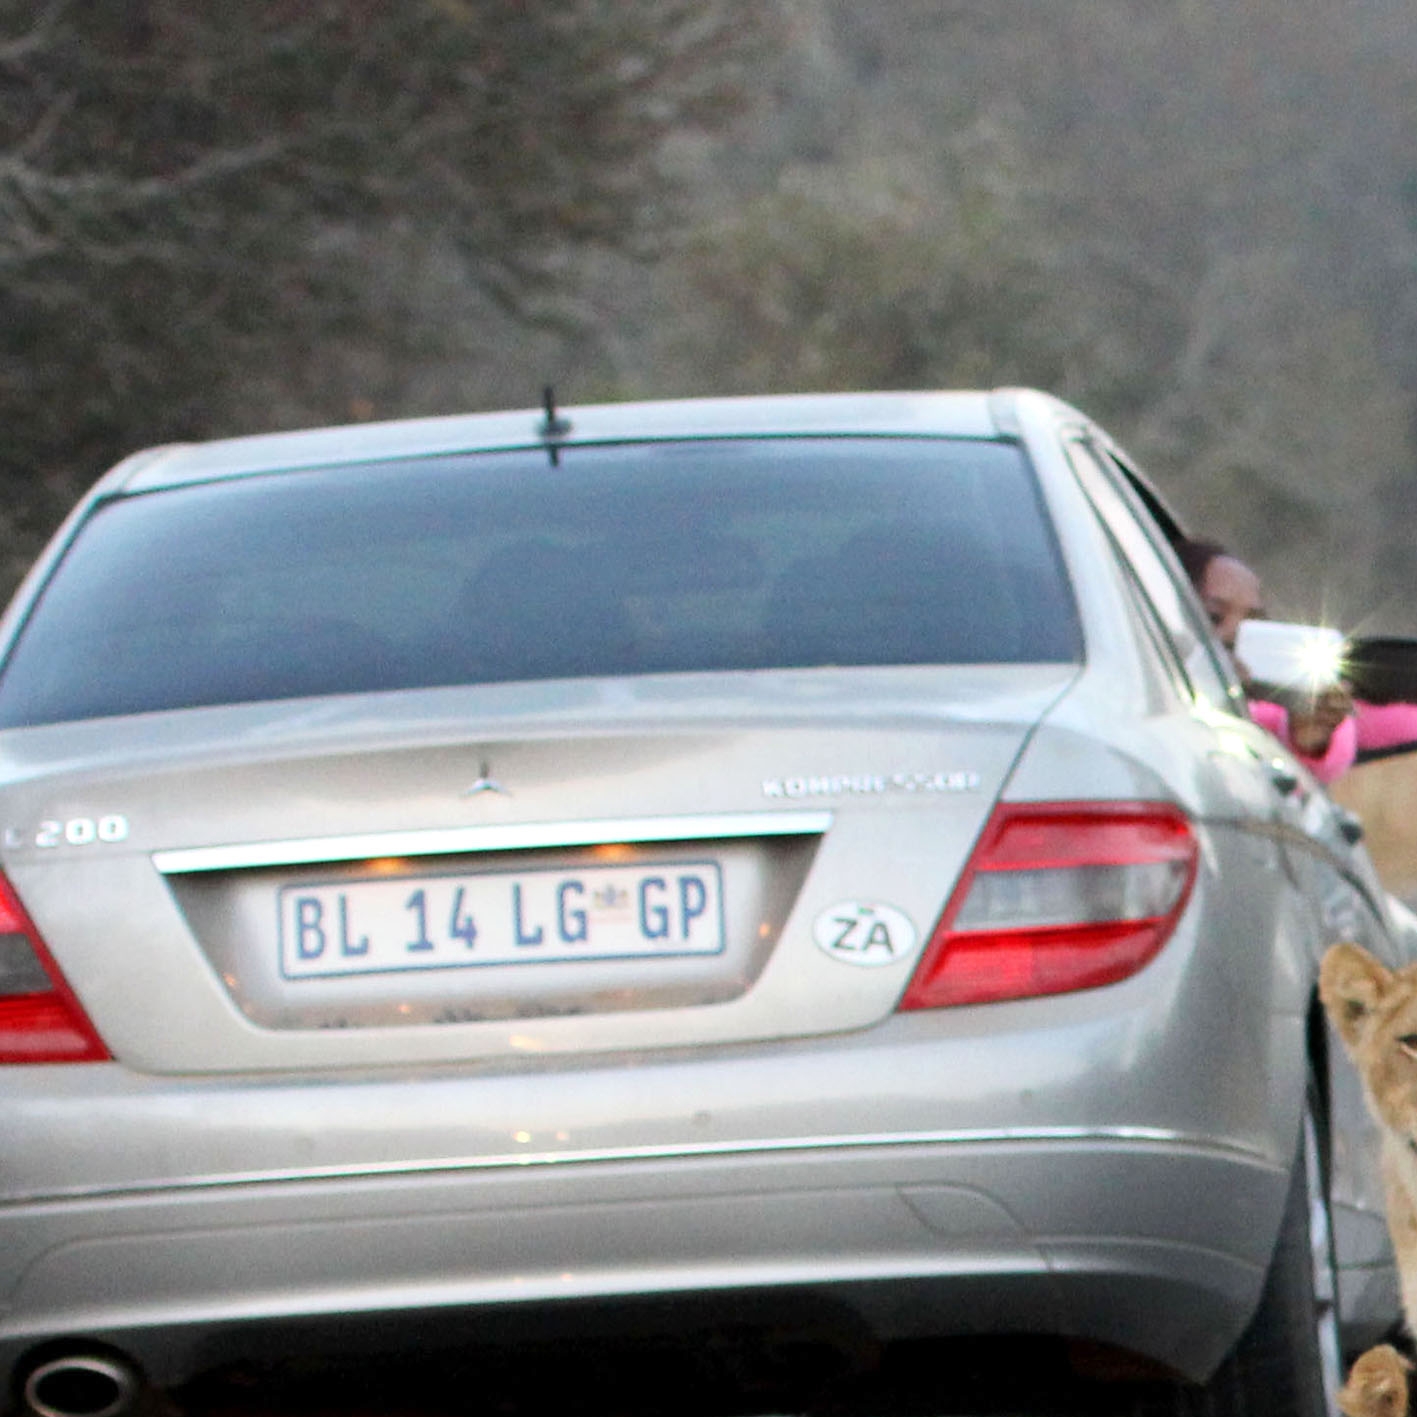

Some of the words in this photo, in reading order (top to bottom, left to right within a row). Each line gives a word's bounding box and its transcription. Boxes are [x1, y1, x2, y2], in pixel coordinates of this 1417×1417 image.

[35, 814, 130, 848] 200
[295, 894, 370, 960] BL
[405, 885, 478, 953] 14
[511, 880, 589, 947] LG
[638, 874, 707, 941] GP
[830, 916, 895, 956] ZA
